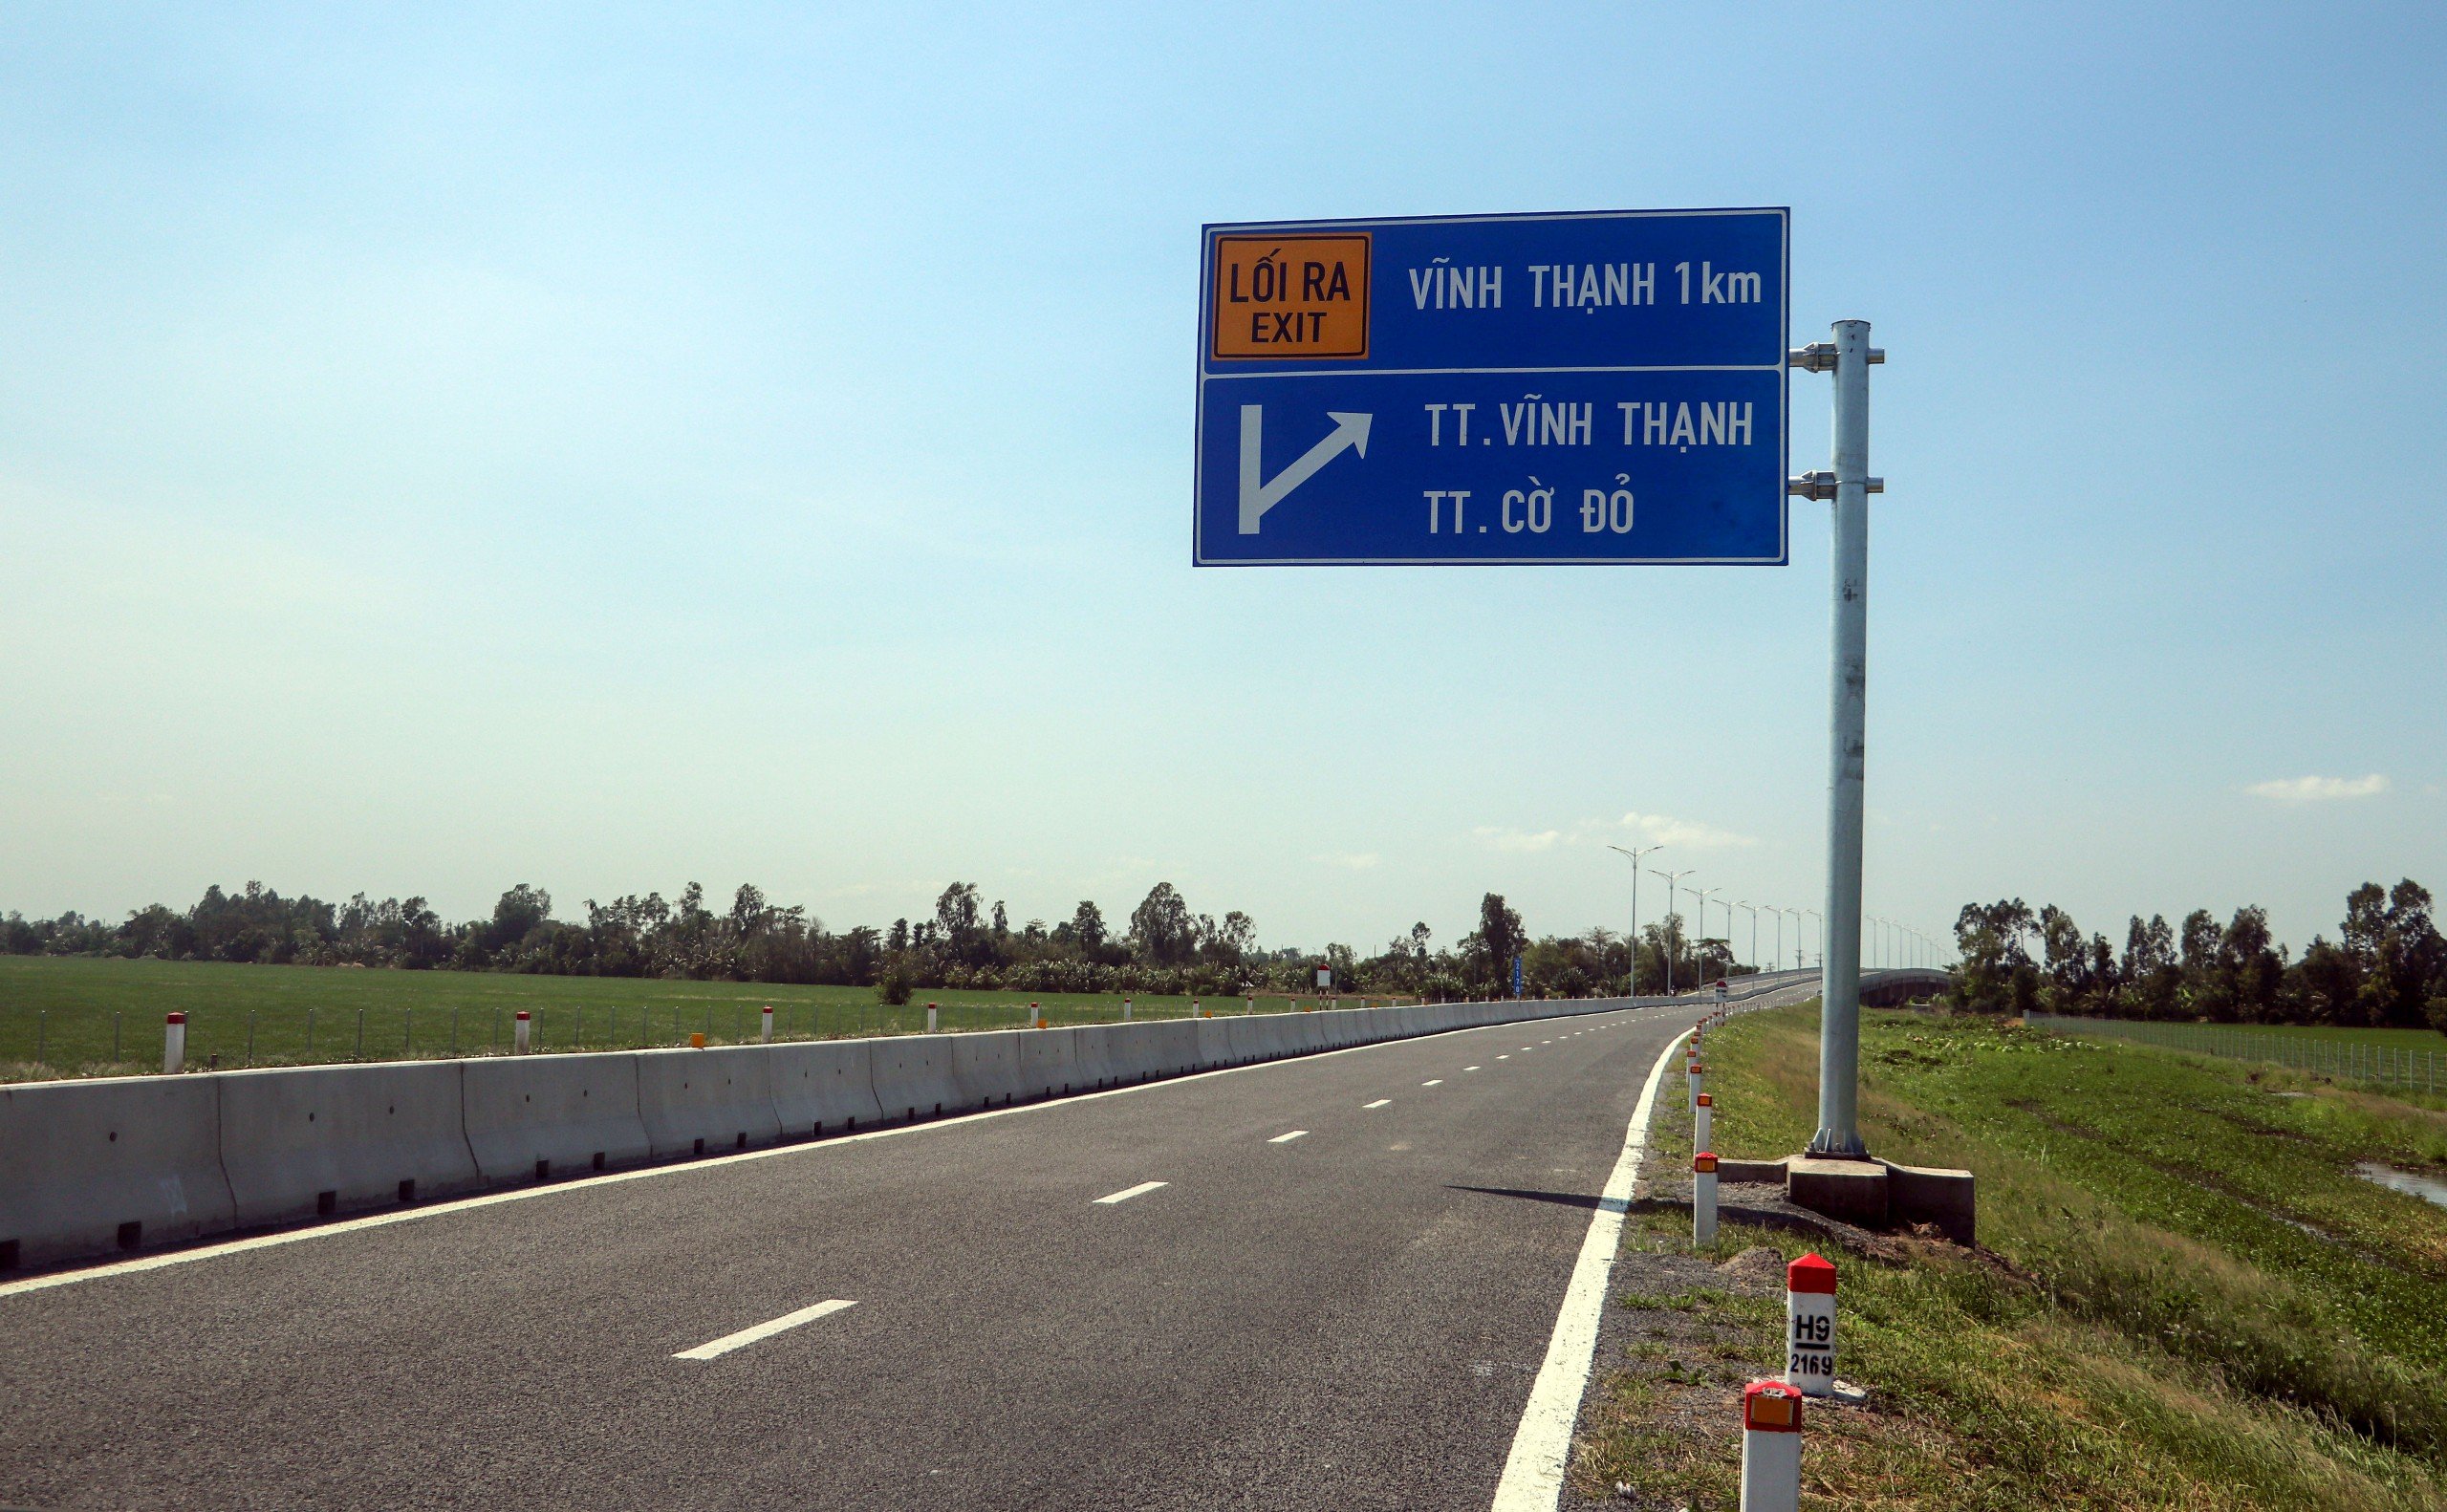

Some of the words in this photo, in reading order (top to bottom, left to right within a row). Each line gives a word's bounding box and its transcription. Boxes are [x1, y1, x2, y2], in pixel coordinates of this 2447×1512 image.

[1229, 248, 1288, 303] LỐI
[1302, 261, 1351, 302] RA
[1409, 258, 1502, 310] VĨNH
[1528, 263, 1655, 313] THẠNH
[1250, 312, 1327, 344] EXIT
[1618, 402, 1753, 452] THẠNH
[1580, 474, 1635, 533] ĐỎ
[1796, 1314, 1830, 1342] H9
[1790, 1353, 1832, 1376] 2169
